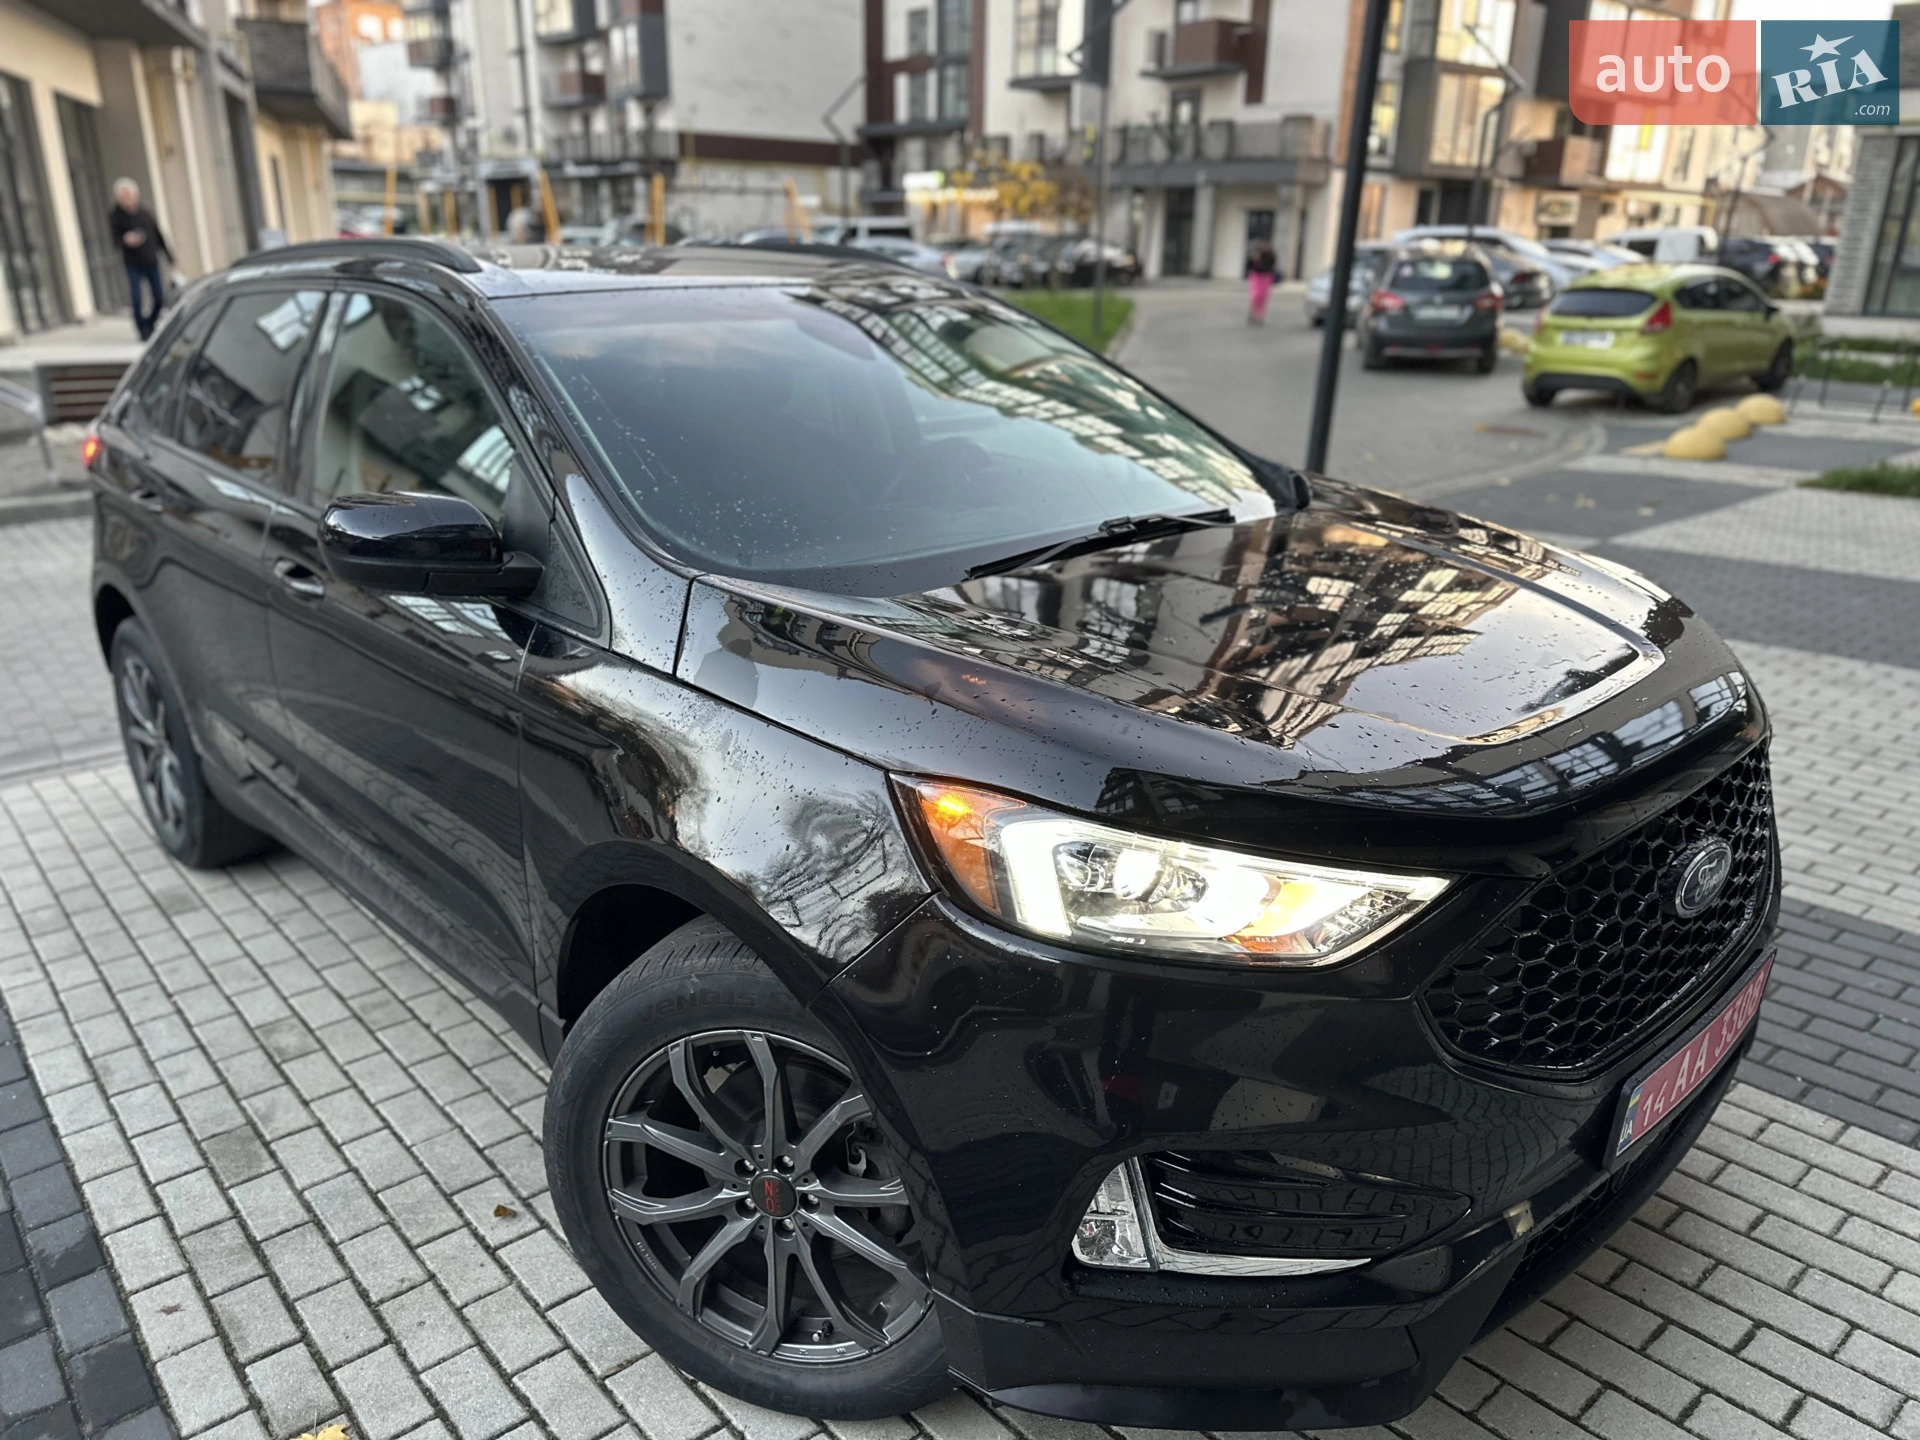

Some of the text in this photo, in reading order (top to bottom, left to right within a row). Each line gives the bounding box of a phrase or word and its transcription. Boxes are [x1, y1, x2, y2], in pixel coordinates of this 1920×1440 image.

[1695, 858, 1725, 903] Ford
[1643, 1080, 1668, 1127] 14
[1670, 1032, 1710, 1103] AA
[1619, 1119, 1633, 1143] UA
